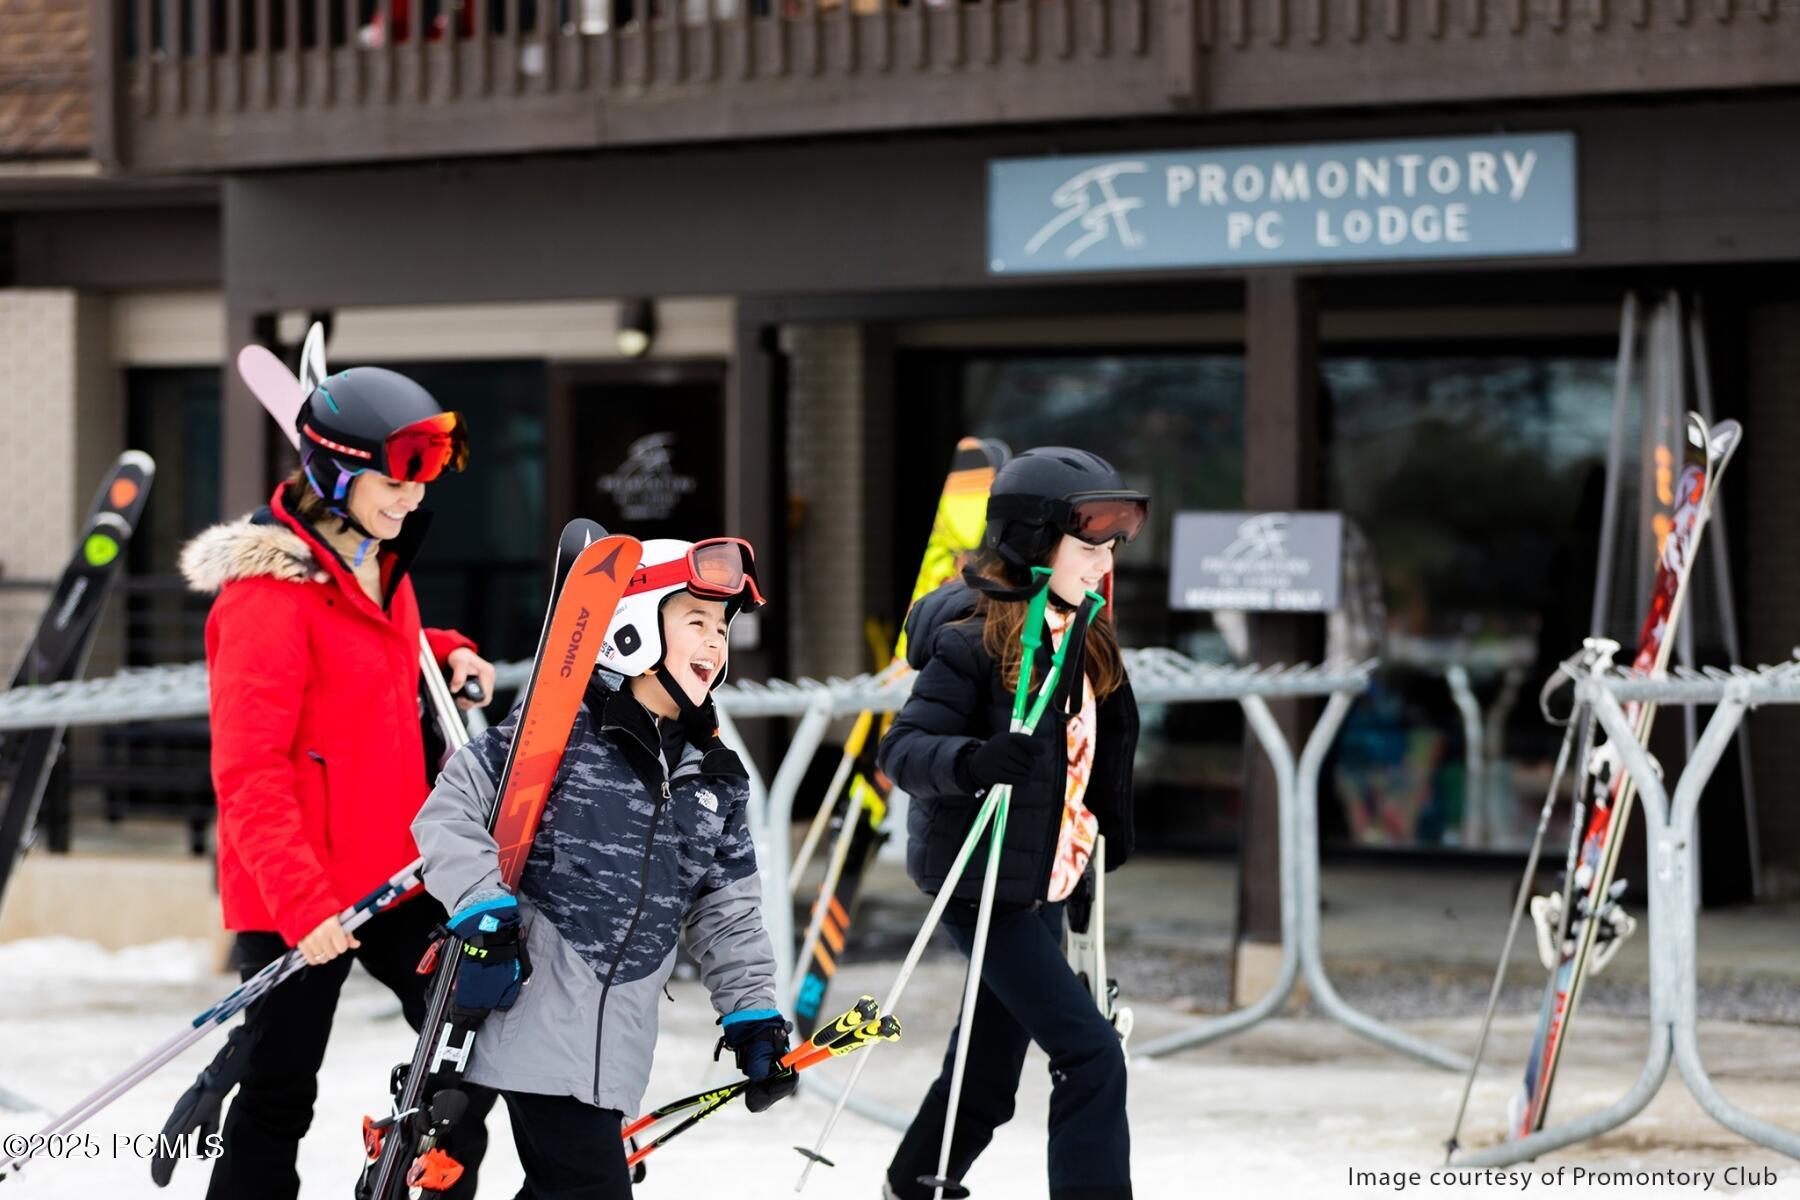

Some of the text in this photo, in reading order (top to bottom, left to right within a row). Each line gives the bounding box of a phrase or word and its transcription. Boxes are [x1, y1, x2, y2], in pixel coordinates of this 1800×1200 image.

[1166, 149, 1537, 207] PROMONTORY
[1227, 203, 1471, 249] PC LODGE
[560, 606, 590, 678] ATOMIC
